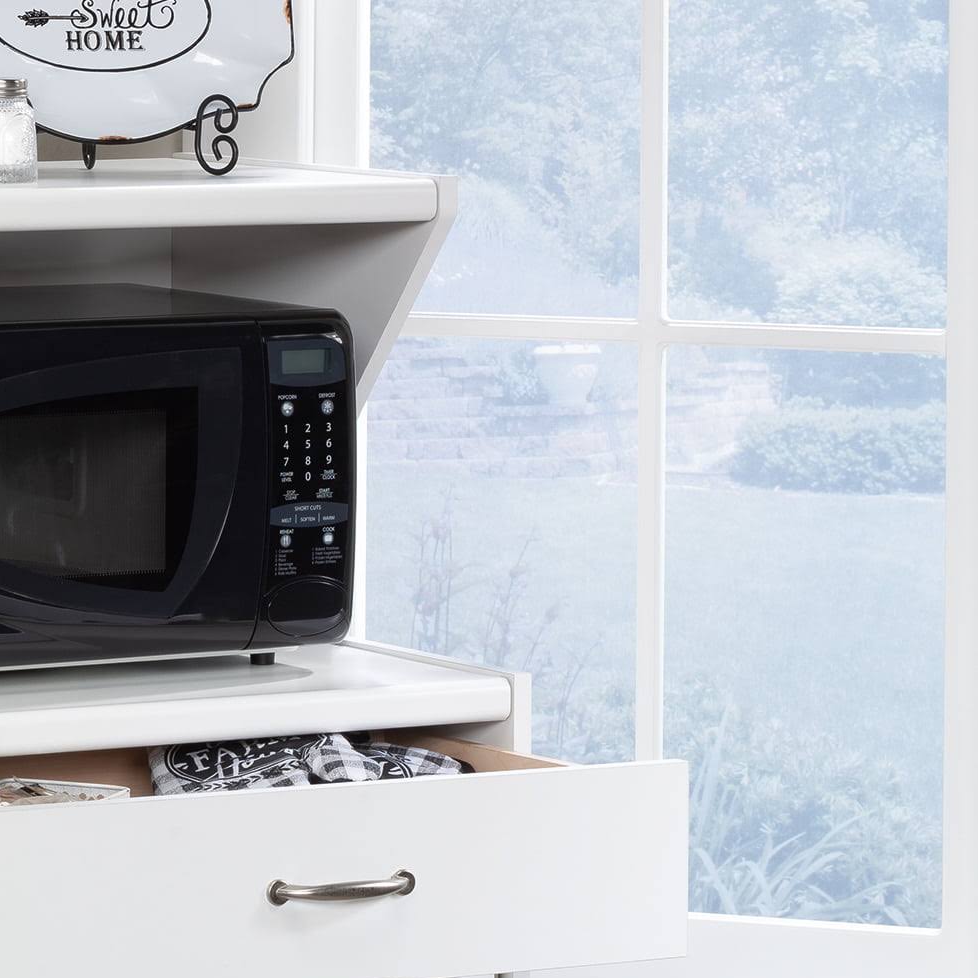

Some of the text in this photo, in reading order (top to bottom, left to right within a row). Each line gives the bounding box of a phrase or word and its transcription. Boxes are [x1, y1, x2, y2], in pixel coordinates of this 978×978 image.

[70, 0, 176, 29] Sweet
[65, 30, 144, 51] HOME
[284, 424, 288, 434] 1
[305, 423, 311, 433] 2
[326, 422, 332, 432] 3
[283, 440, 289, 450] 4
[305, 439, 311, 449] 5
[326, 438, 332, 448] 6
[283, 457, 289, 467] 7
[305, 456, 311, 466] 8
[326, 454, 332, 465] 9
[305, 471, 311, 482] 0
